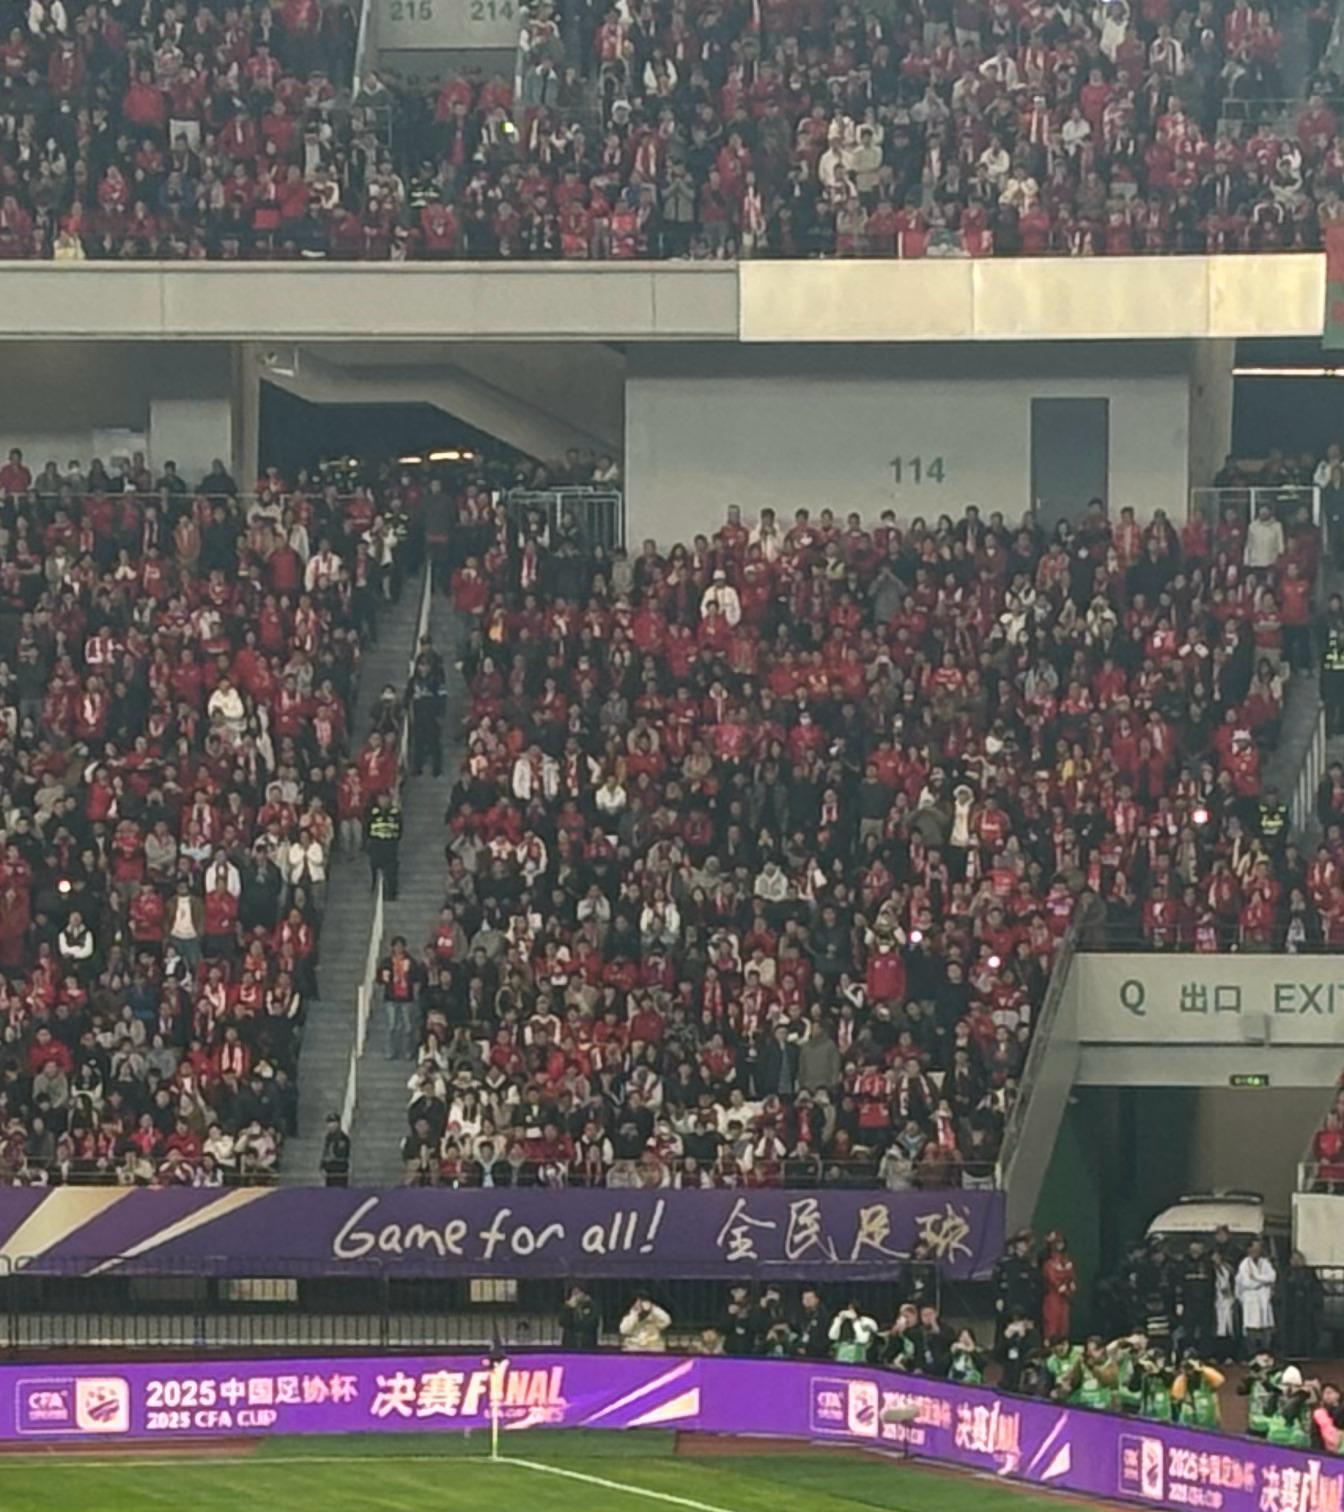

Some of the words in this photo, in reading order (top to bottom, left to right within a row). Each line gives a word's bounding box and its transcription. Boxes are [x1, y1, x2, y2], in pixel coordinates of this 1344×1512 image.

[391, 0, 432, 21] 215
[471, 0, 513, 21] 214
[890, 456, 945, 484] 114
[1119, 980, 1146, 1016] Q
[1180, 982, 1242, 1014] 出口
[333, 1197, 466, 1258] Game
[479, 1207, 565, 1259] for
[582, 1199, 665, 1254] all!
[716, 1198, 974, 1263] 全民足球
